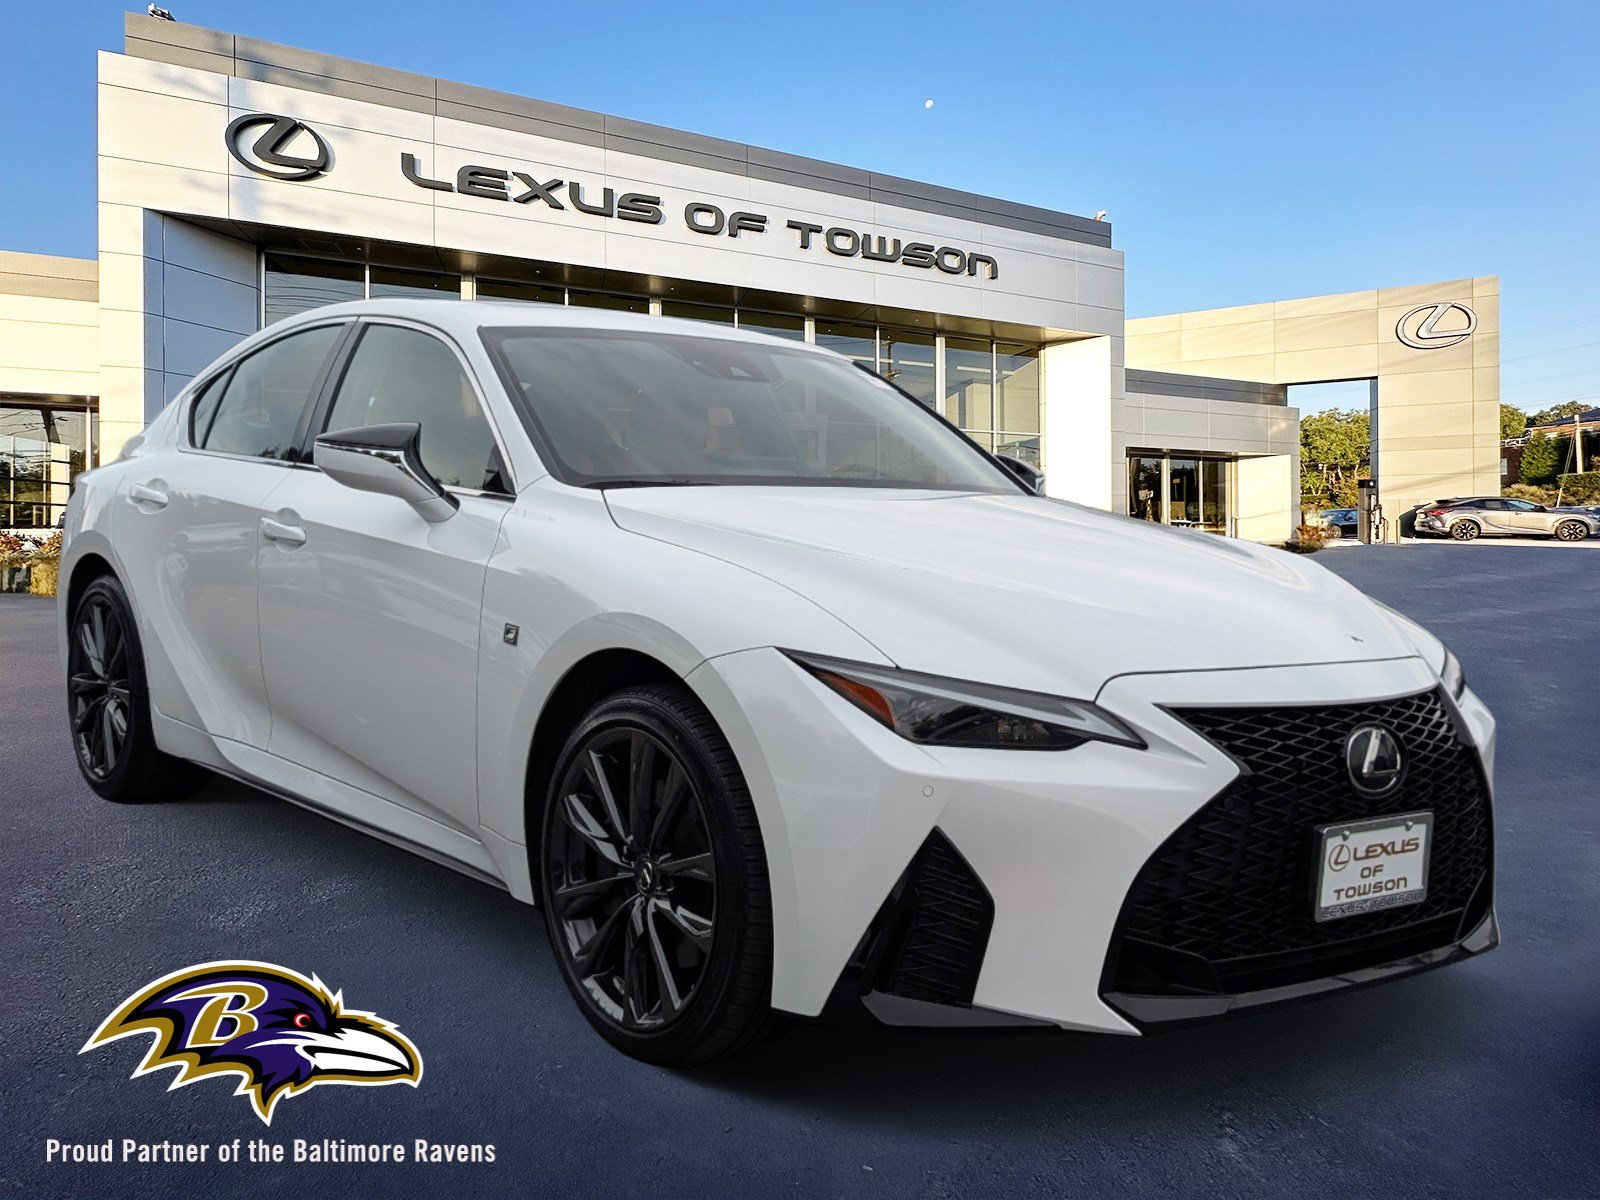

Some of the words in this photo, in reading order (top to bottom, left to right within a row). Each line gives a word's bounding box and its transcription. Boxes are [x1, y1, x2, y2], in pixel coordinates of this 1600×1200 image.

[401, 152, 664, 225] LEXUS
[684, 201, 768, 238] OF
[786, 219, 999, 280] TOWSON
[1353, 837, 1420, 861] LEXUS
[1360, 864, 1384, 879] OF
[1334, 877, 1408, 901] TOWSON
